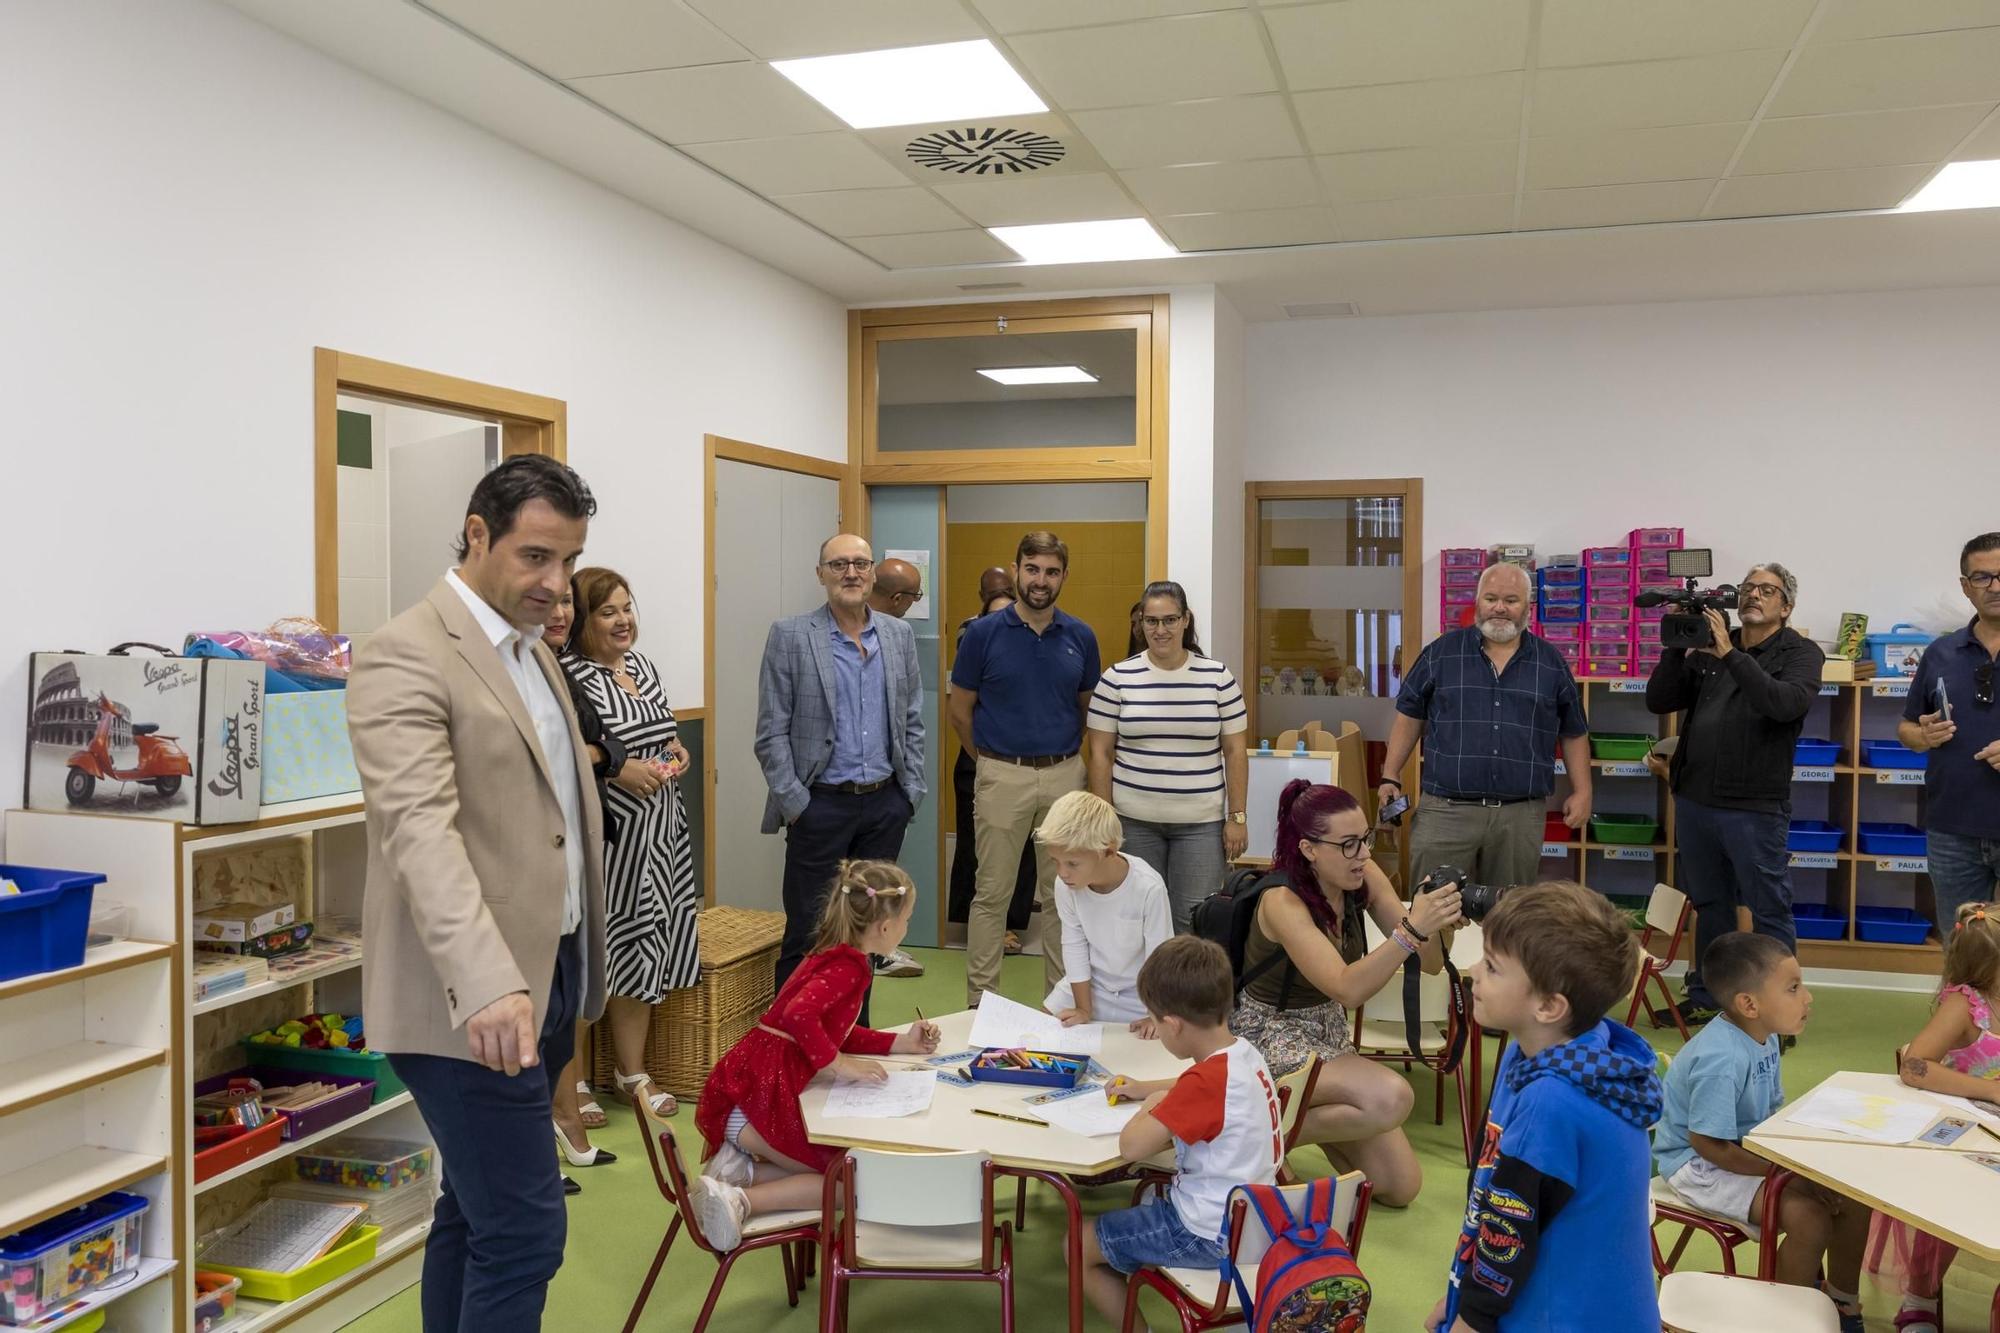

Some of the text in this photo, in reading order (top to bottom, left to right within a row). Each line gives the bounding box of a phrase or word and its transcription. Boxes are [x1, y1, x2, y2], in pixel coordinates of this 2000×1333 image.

[144, 660, 182, 687] Vespa
[158, 678, 179, 694] Grand
[243, 679, 260, 770] Grand Sport
[208, 712, 243, 800] Vespa
[1801, 770, 1829, 778] GEORGI
[1622, 850, 1649, 858] MATEO
